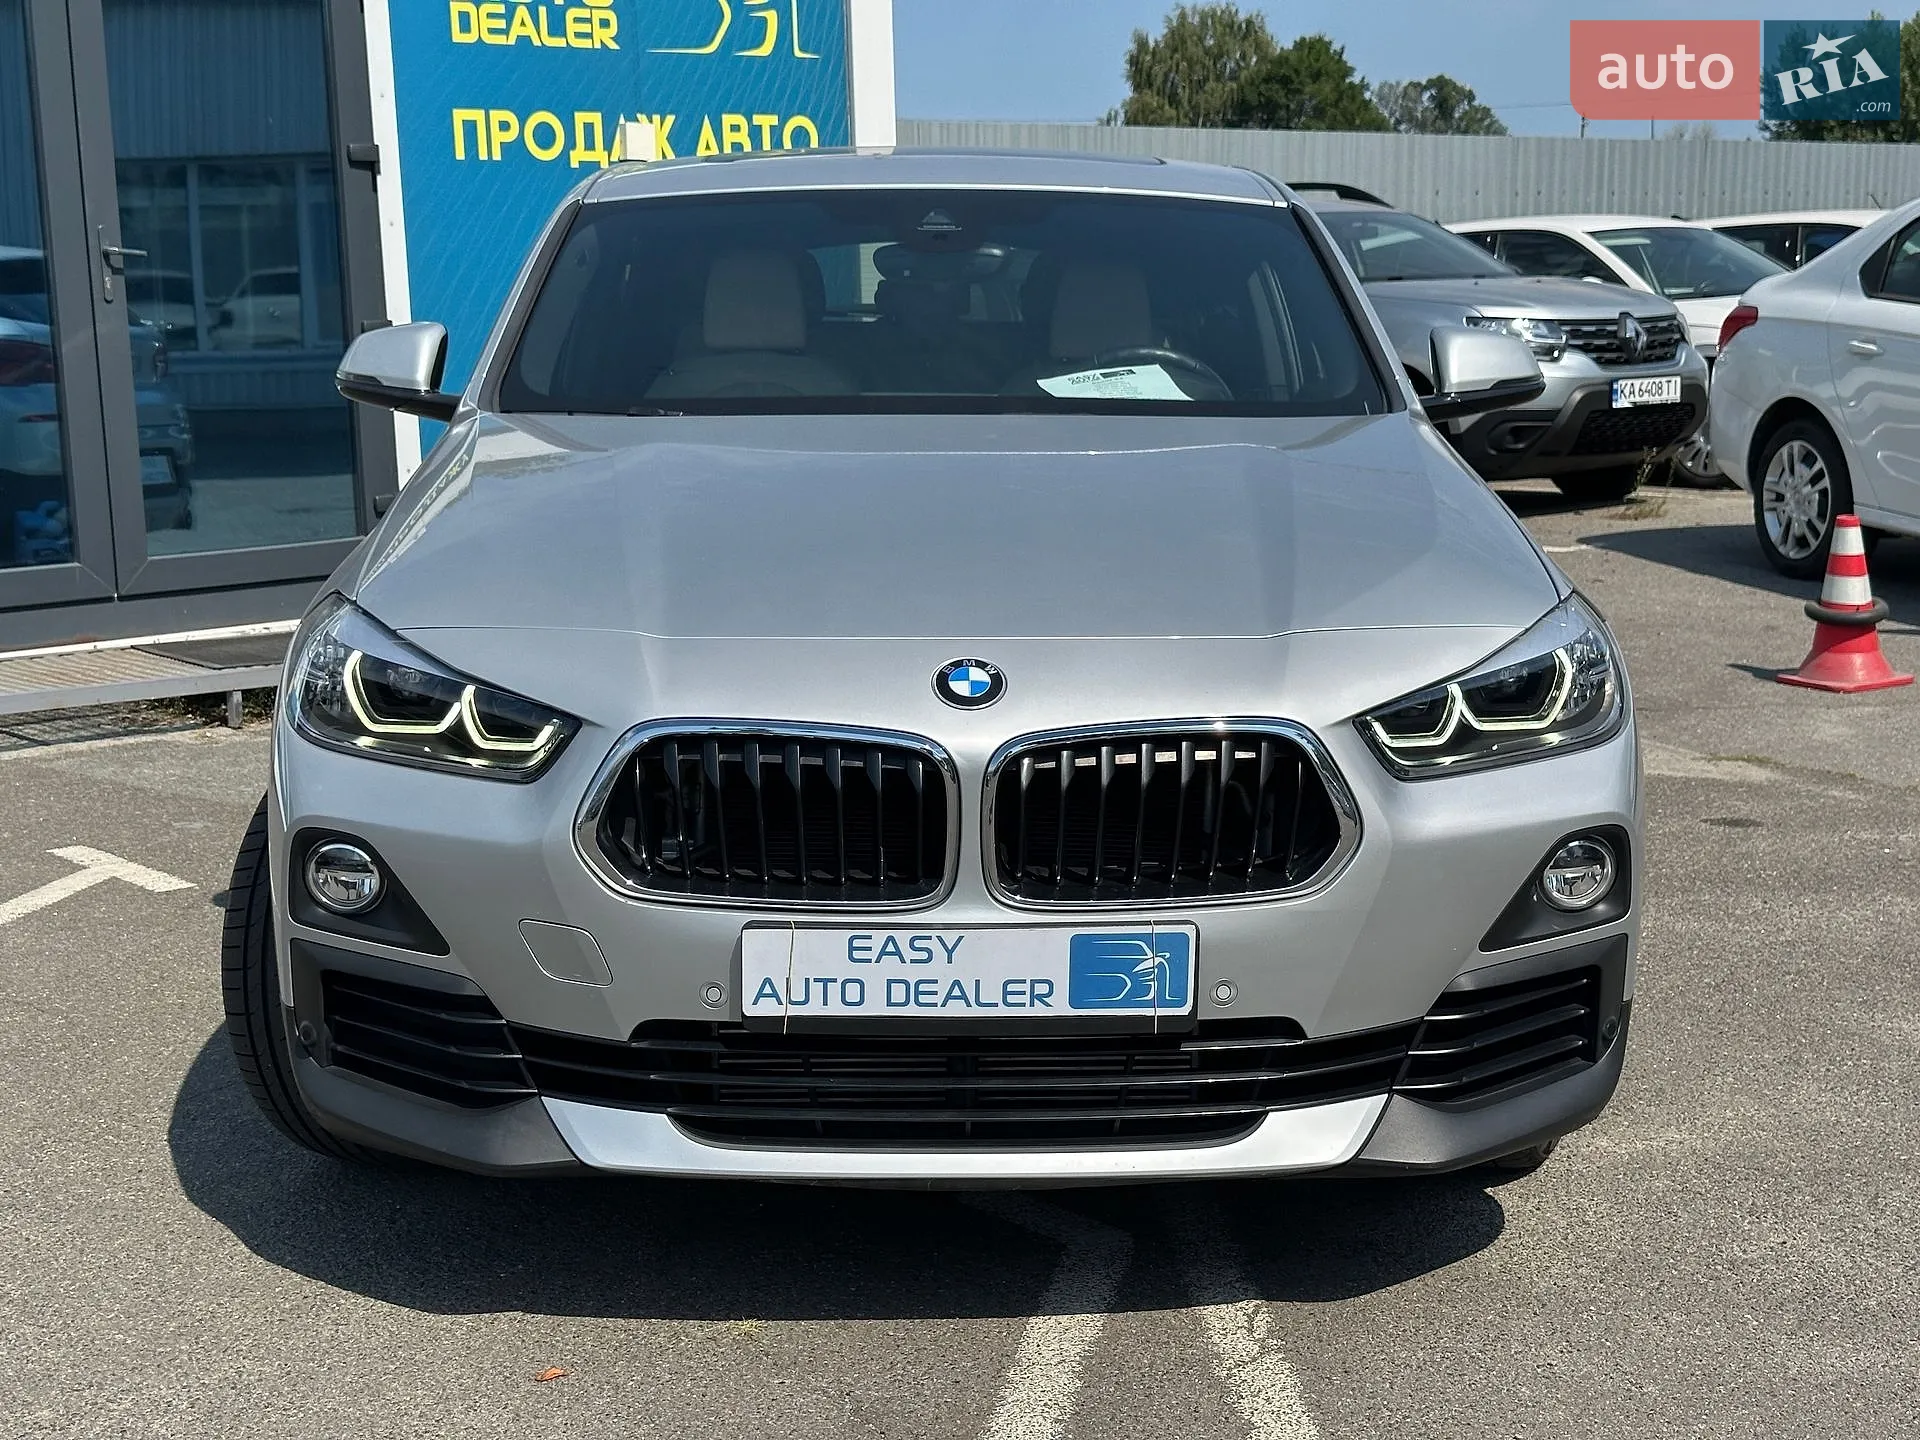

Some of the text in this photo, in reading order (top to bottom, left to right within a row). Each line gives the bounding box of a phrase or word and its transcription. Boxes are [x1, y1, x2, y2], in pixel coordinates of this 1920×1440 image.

[450, 1, 620, 49] DEALER
[696, 112, 819, 157] АВТО
[1638, 380, 1663, 398] 6408
[942, 659, 998, 675] BMW
[847, 934, 965, 965] EASY
[751, 976, 1055, 1008] AUTO DEALER
